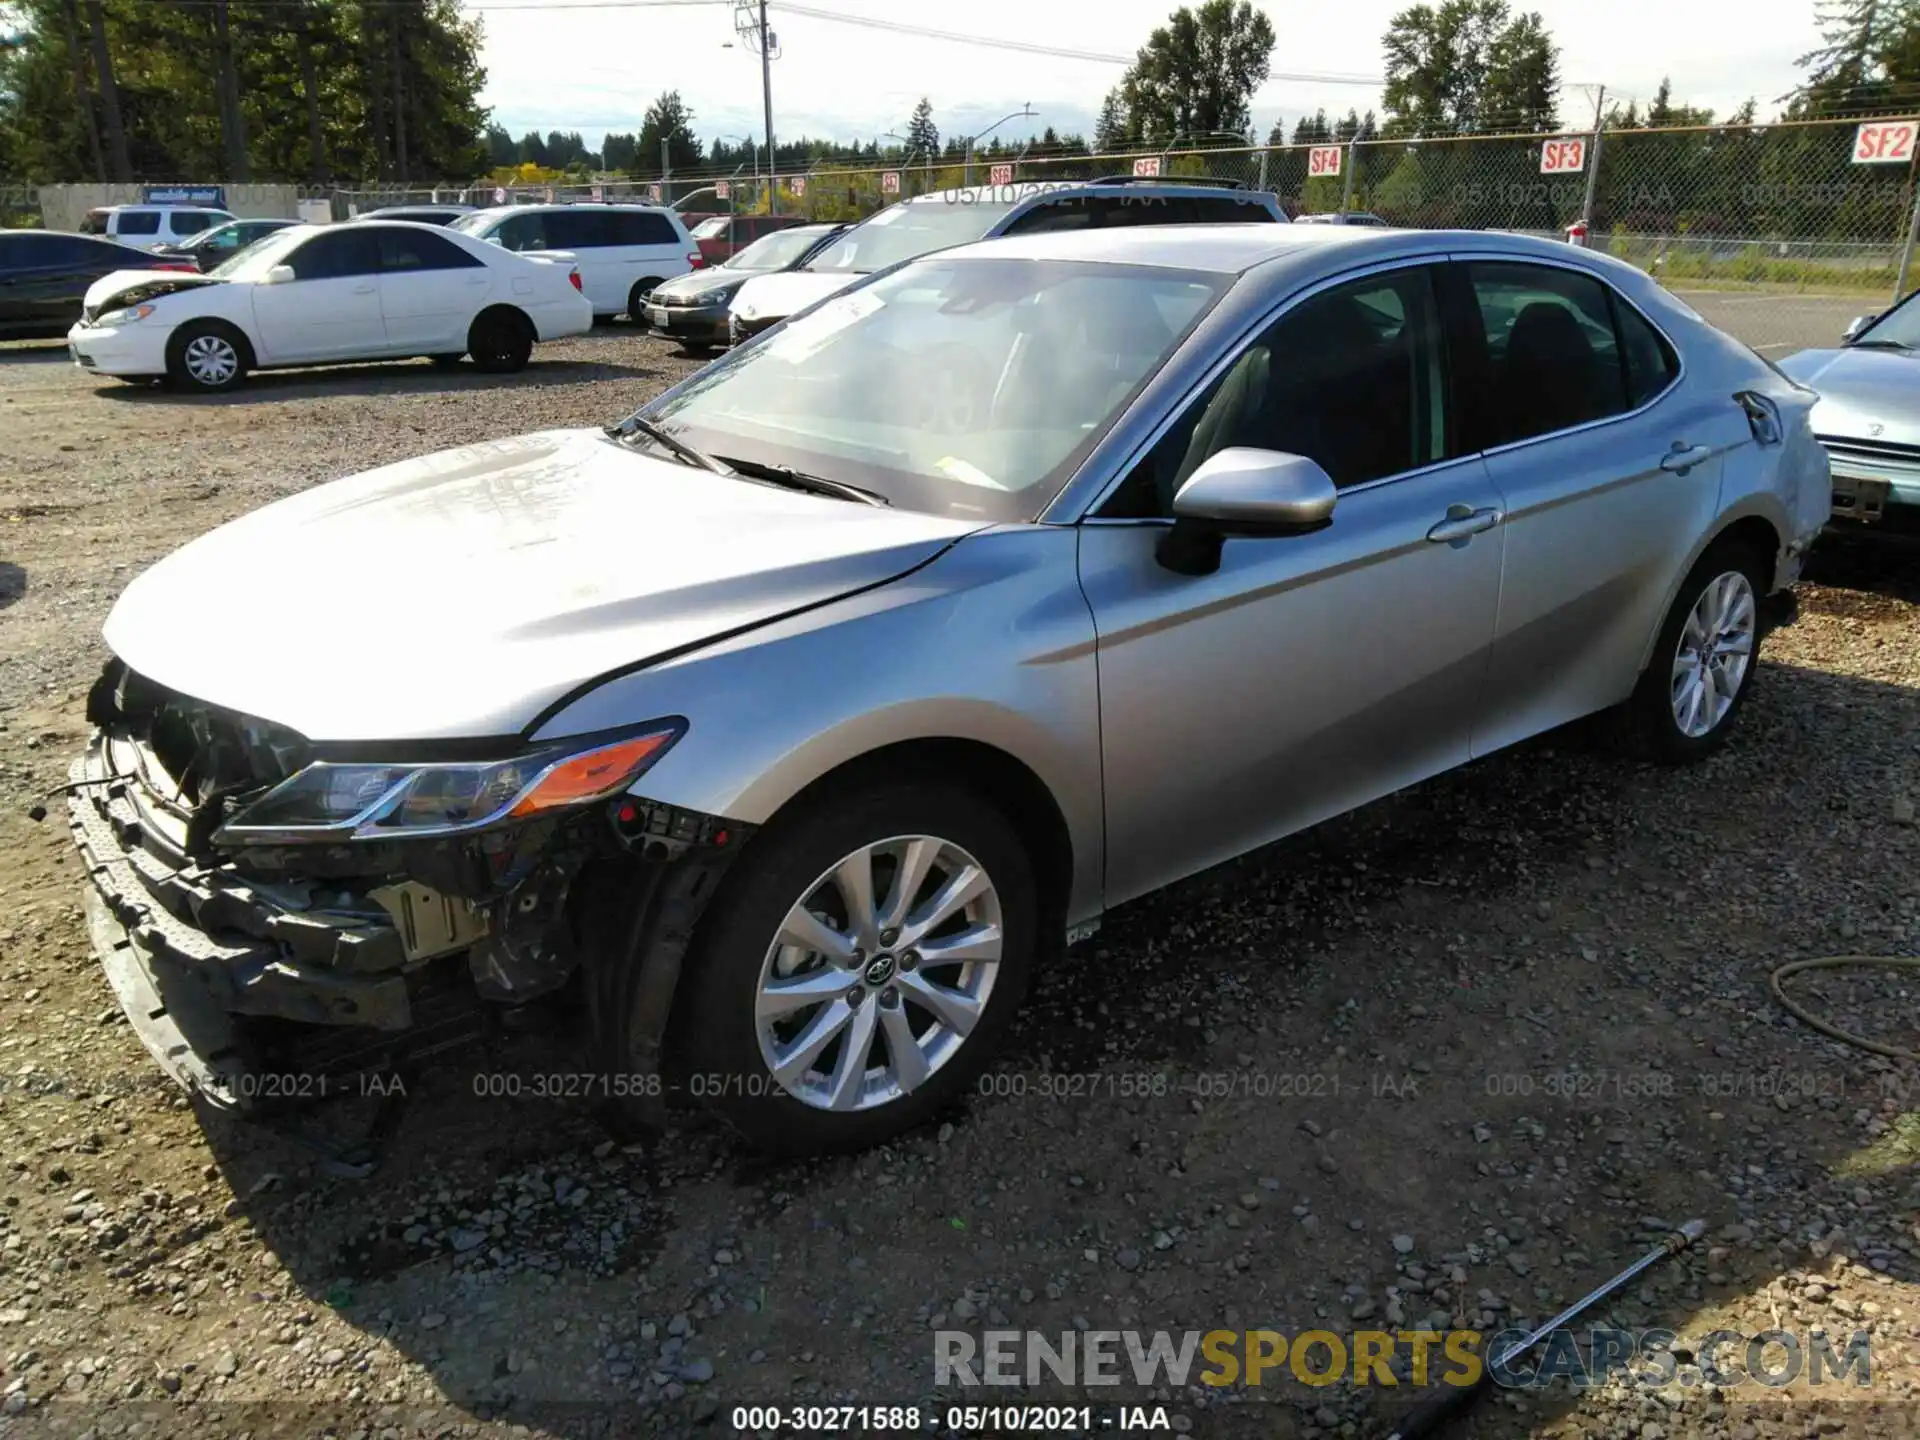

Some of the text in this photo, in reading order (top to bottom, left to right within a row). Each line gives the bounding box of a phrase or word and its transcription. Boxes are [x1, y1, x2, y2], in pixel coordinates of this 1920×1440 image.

[1545, 140, 1582, 169] SF3
[1857, 126, 1912, 159] SF2
[1311, 149, 1338, 174] SF4
